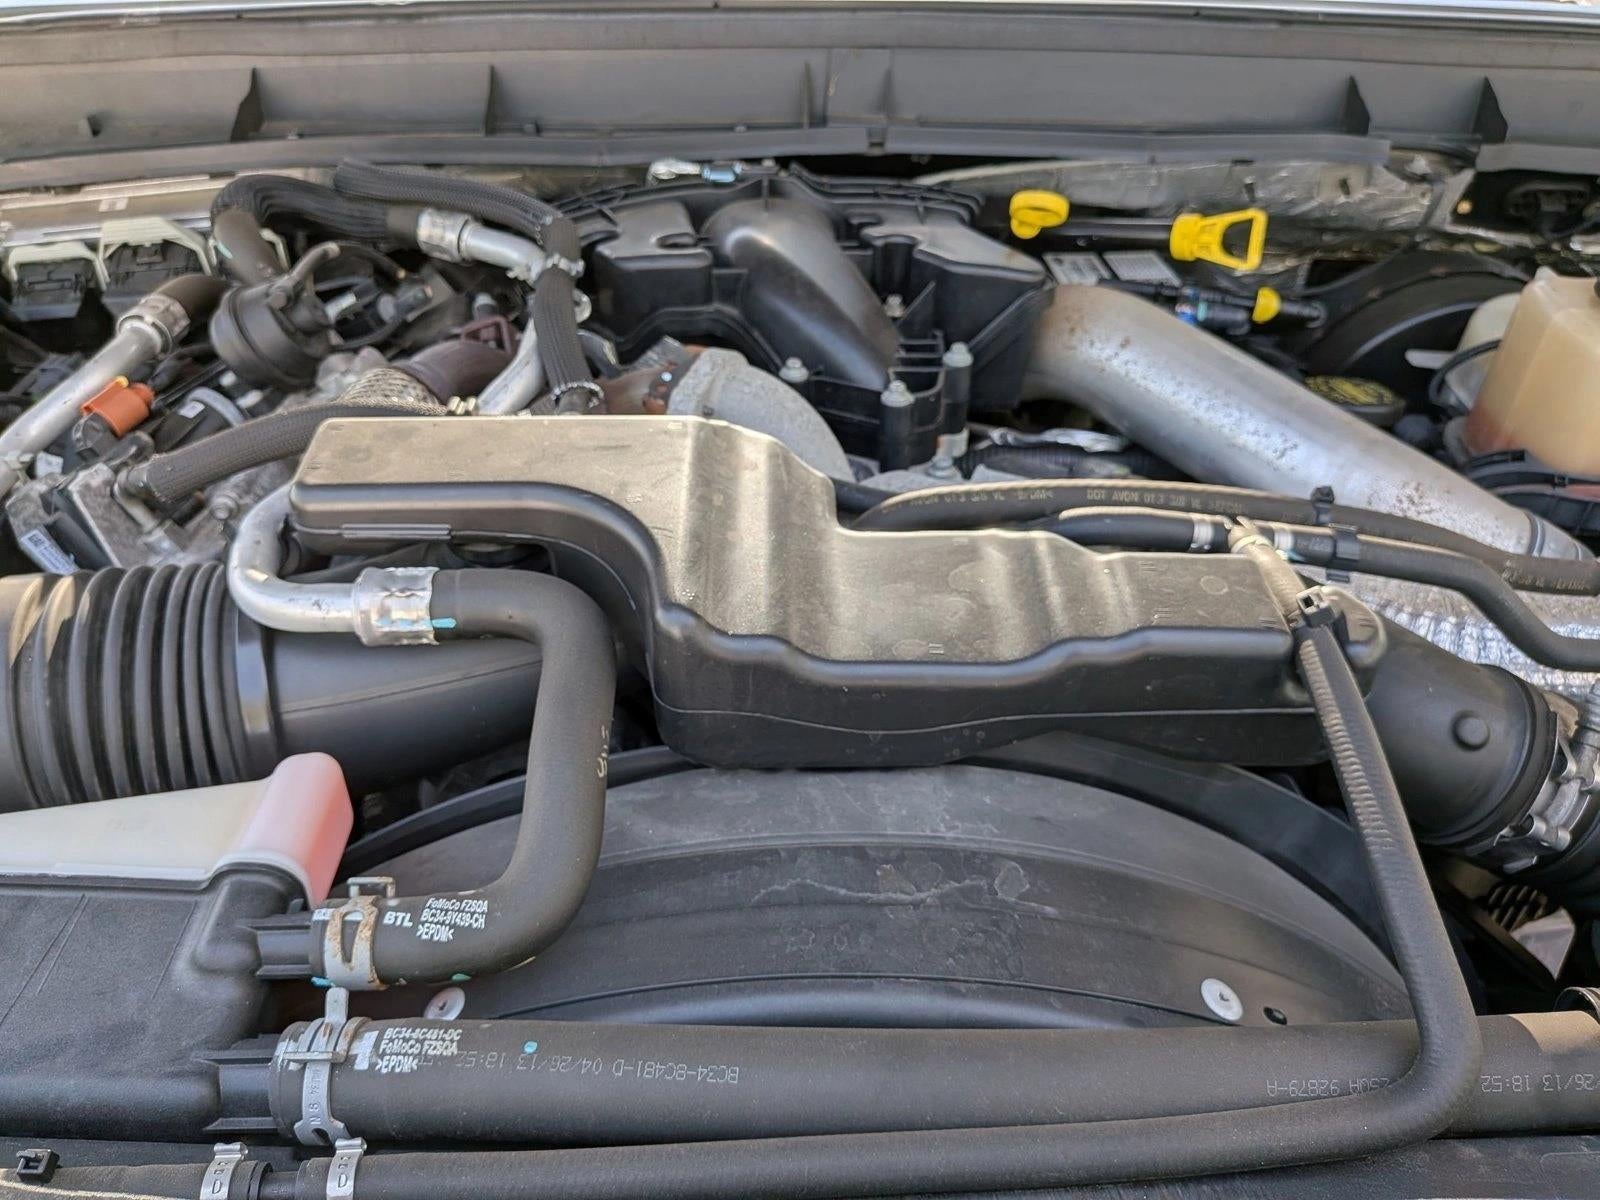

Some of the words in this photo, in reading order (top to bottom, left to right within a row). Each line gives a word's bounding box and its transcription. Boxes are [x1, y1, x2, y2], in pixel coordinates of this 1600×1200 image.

[425, 897, 461, 910] FoMoCo
[382, 910, 413, 927] BTL
[379, 1038, 421, 1055] FoMoCo
[516, 1052, 603, 1076] 04/26/13
[611, 1058, 740, 1084] BC34-8C481-D
[1265, 1078, 1340, 1097] 92879-A
[1479, 1074, 1532, 1093] 18:52
